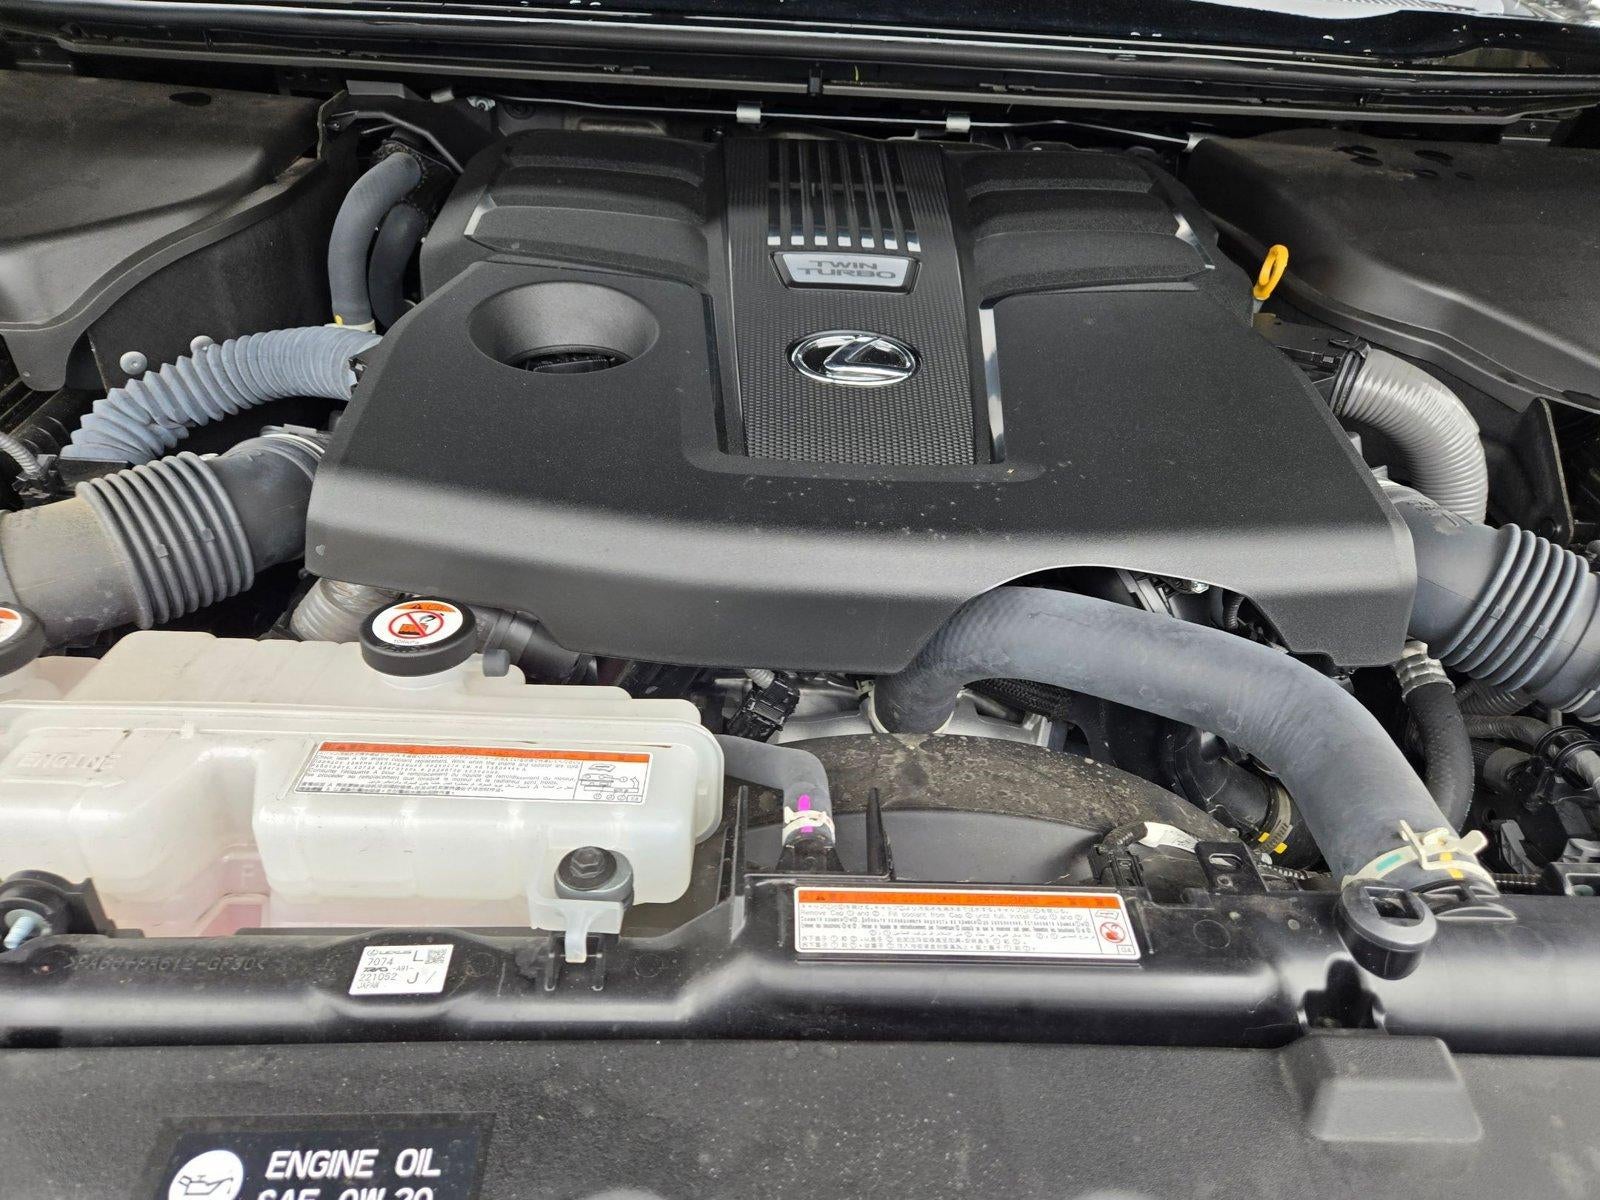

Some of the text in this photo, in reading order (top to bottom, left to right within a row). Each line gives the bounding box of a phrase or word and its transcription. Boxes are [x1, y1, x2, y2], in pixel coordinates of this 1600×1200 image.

[809, 259, 878, 270] TWIN
[797, 267, 896, 279] TURBO
[367, 957, 394, 966] 7074
[413, 950, 424, 962] L
[359, 972, 398, 982] 221052
[407, 972, 420, 984] J
[265, 1148, 442, 1179] ENGINE OIL
